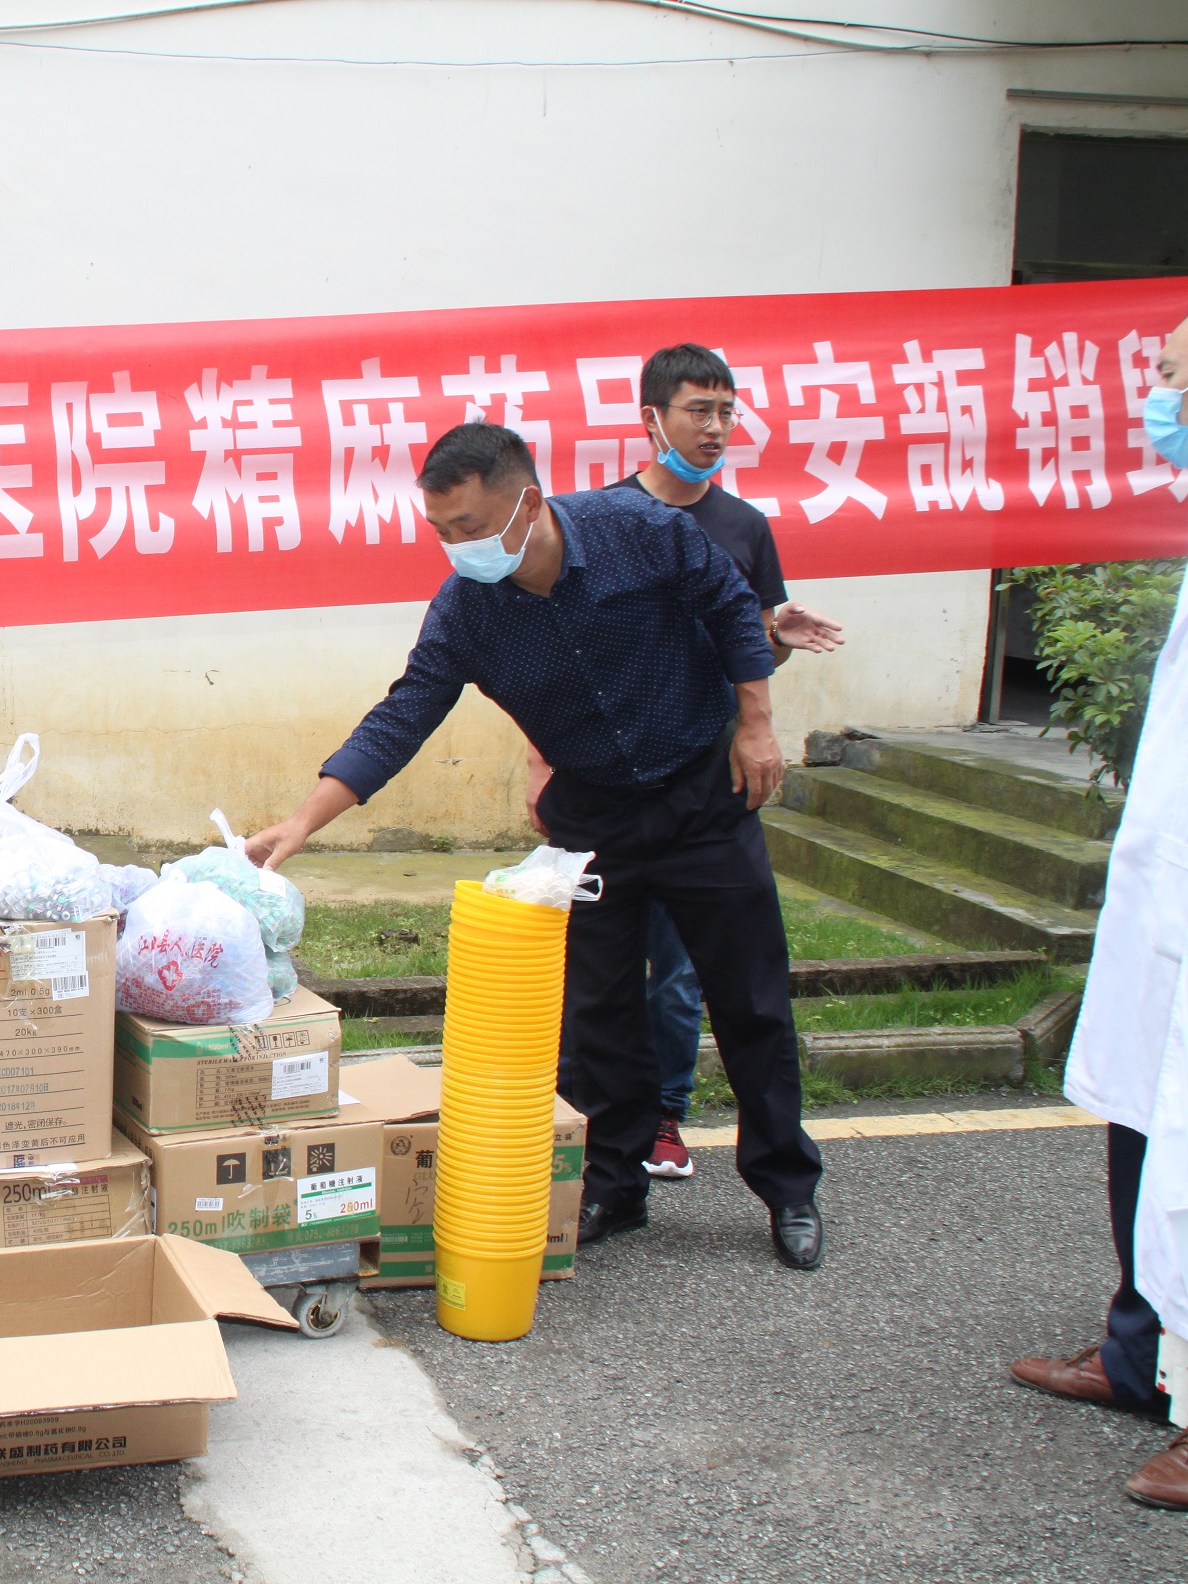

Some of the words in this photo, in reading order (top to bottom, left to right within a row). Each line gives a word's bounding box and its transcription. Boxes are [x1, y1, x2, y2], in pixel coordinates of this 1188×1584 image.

[14, 1027, 38, 1037] 20kg
[310, 1175, 363, 1191] 葡萄糖注射液
